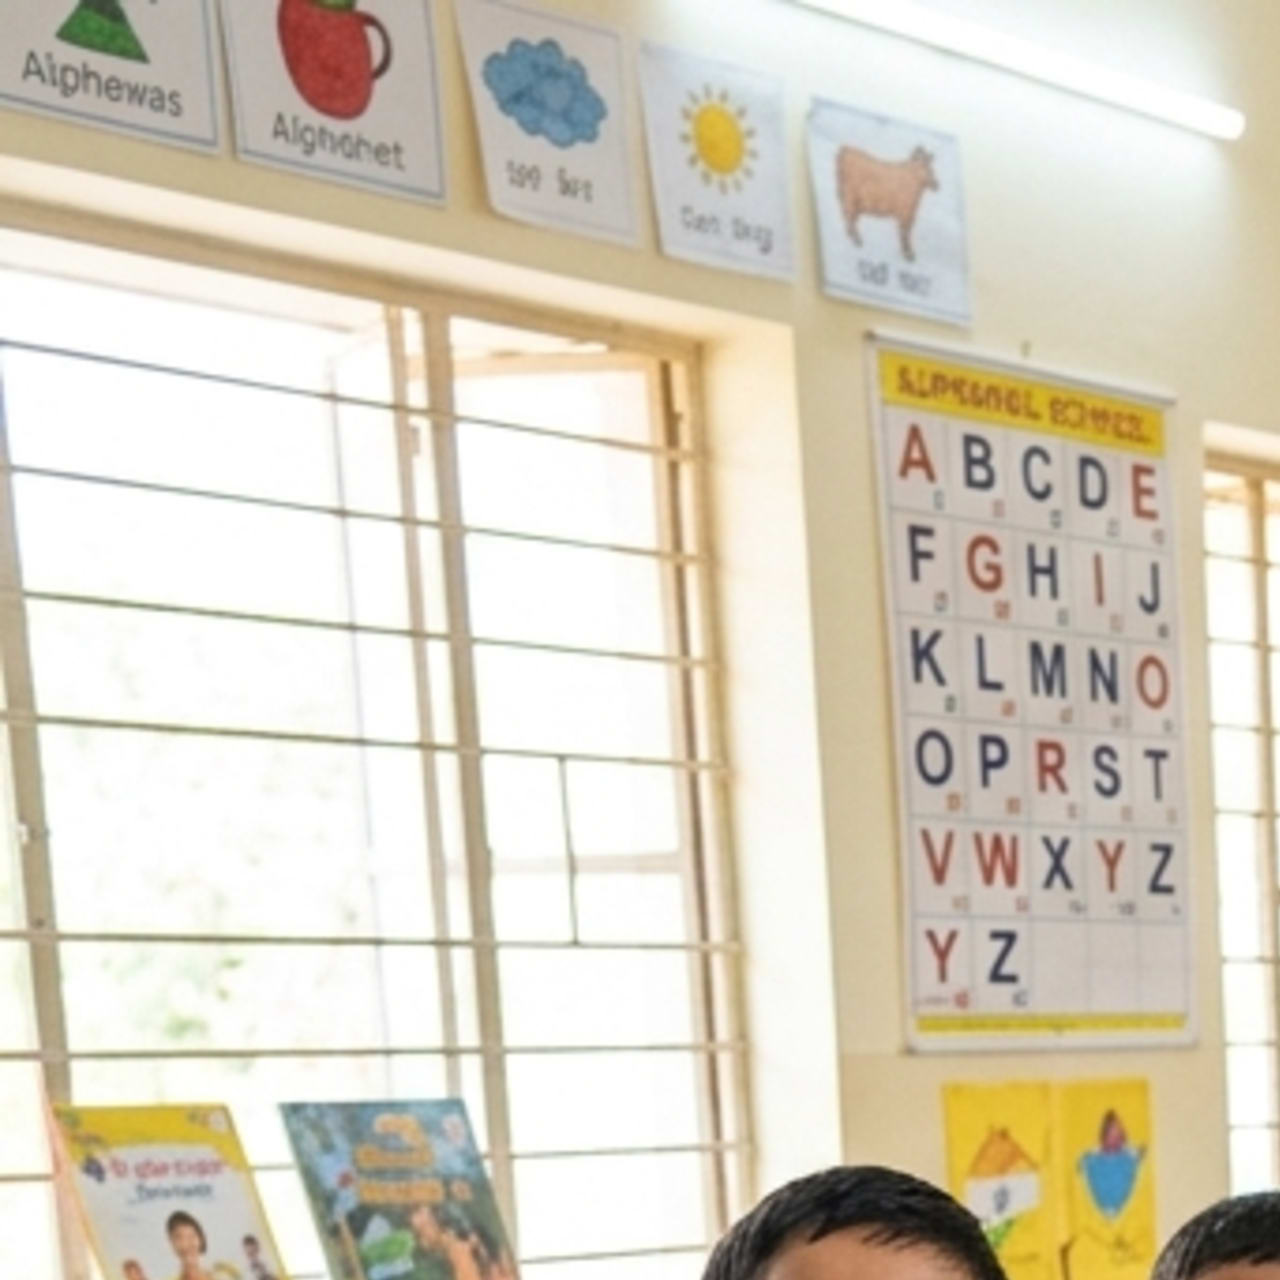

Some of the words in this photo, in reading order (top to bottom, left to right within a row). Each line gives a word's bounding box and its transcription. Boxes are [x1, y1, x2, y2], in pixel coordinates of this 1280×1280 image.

[898, 423, 936, 484] A
[962, 434, 995, 490] B
[1022, 446, 1052, 501] C
[1079, 455, 1108, 510] D
[1132, 463, 1159, 521] E
[908, 525, 935, 583] F
[967, 534, 1004, 592] G
[1027, 543, 1058, 600] H
[1094, 552, 1104, 606] I
[1139, 562, 1160, 615] J
[910, 628, 946, 687] K
[976, 634, 1004, 692] L
[1029, 640, 1067, 698] M
[1088, 647, 1118, 704] N
[1136, 654, 1169, 710] O
[915, 729, 954, 786] O
[979, 734, 1009, 788] P
[1035, 739, 1068, 794] R
[1093, 746, 1121, 798] S
[1144, 749, 1168, 801] T
[920, 828, 954, 886] V
[974, 832, 1018, 889] W
[1042, 835, 1073, 891] X
[1096, 839, 1125, 893] Y
[1148, 843, 1174, 894] Z
[925, 929, 958, 984] Y
[989, 930, 1019, 985] Z
